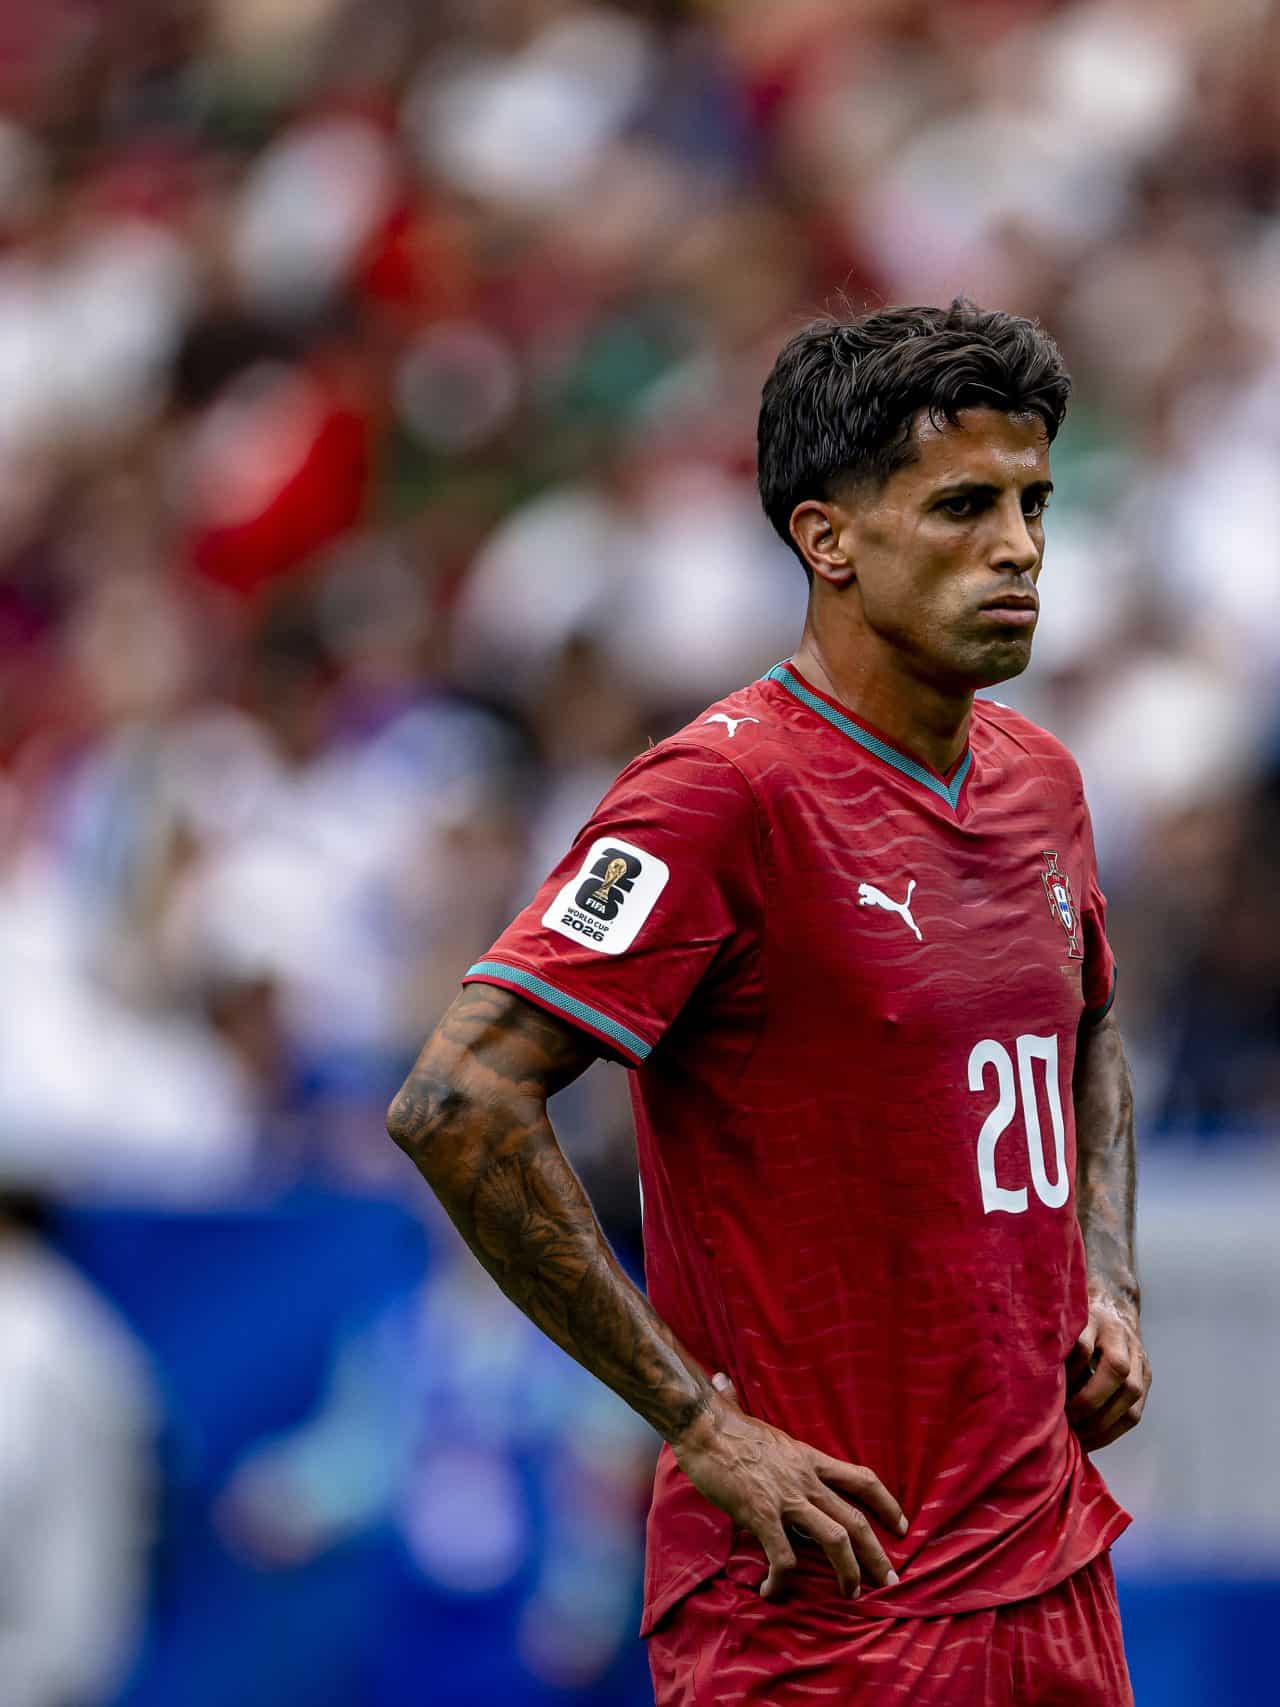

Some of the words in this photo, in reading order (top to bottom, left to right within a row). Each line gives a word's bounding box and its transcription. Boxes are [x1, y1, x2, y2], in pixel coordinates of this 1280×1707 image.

[585, 897, 606, 914] FIFA
[561, 914, 605, 942] 2026
[567, 907, 594, 925] WORLD
[593, 921, 610, 932] CUP
[967, 1032, 1070, 1214] 20
